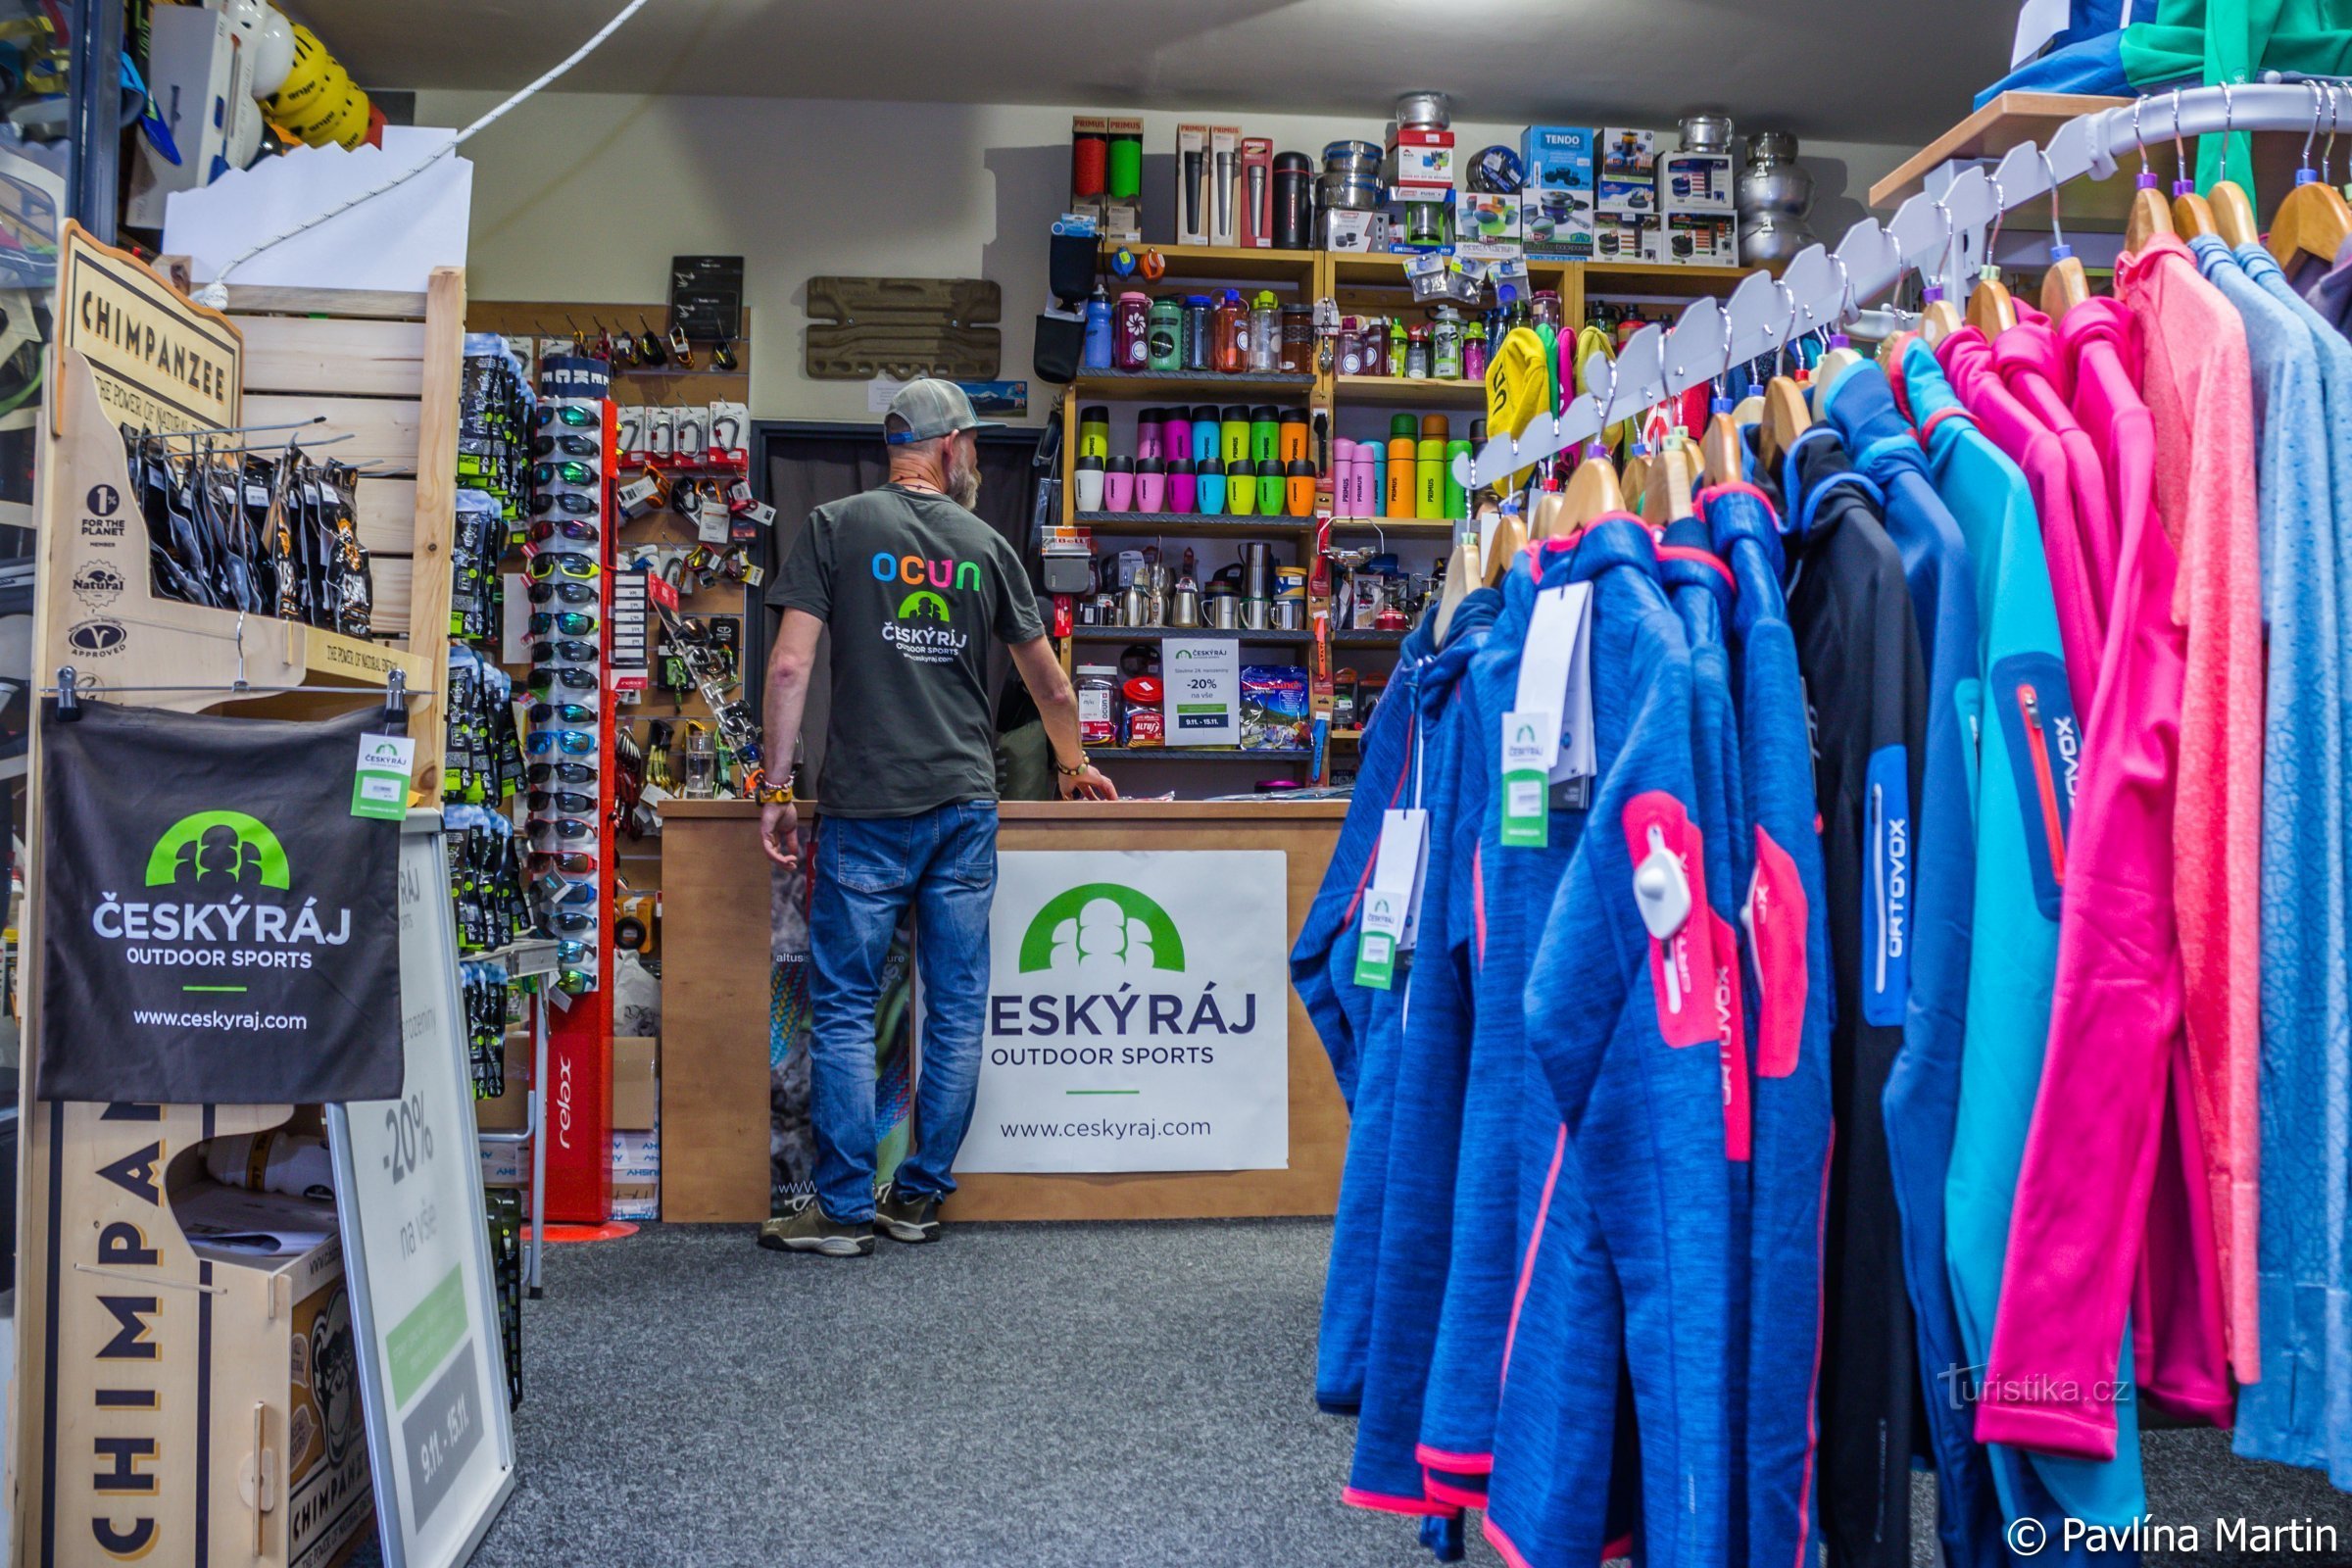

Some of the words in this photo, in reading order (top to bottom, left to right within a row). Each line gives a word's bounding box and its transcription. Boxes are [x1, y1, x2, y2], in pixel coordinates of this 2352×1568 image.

[1074, 120, 1105, 128] PRIMUS
[1544, 134, 1580, 144] TENDO
[81, 290, 225, 406] CHIMPANZEE
[114, 382, 142, 416] POWER
[143, 401, 155, 421] OF
[81, 519, 103, 528] FOR
[73, 579, 123, 592] Natural
[72, 643, 126, 658] APPROVED
[927, 647, 959, 656] SPORTS
[1187, 678, 1217, 689] -20%
[1886, 817, 1906, 958] ORTOVOX
[126, 947, 226, 967] OUTDOOR
[231, 949, 313, 970] SPORTS
[133, 1008, 308, 1032] www.ceskyraj.com
[991, 982, 1257, 1037] ESKÝRÁJ
[991, 1047, 1114, 1066] OUTDOOR
[1121, 1046, 1214, 1065] SPORTS
[558, 1054, 572, 1150] relax
[382, 1090, 434, 1186] -20%
[1000, 1117, 1212, 1141] www.ceskyraj.com
[400, 1221, 416, 1261] na
[92, 1102, 165, 1562] CHIMPA
